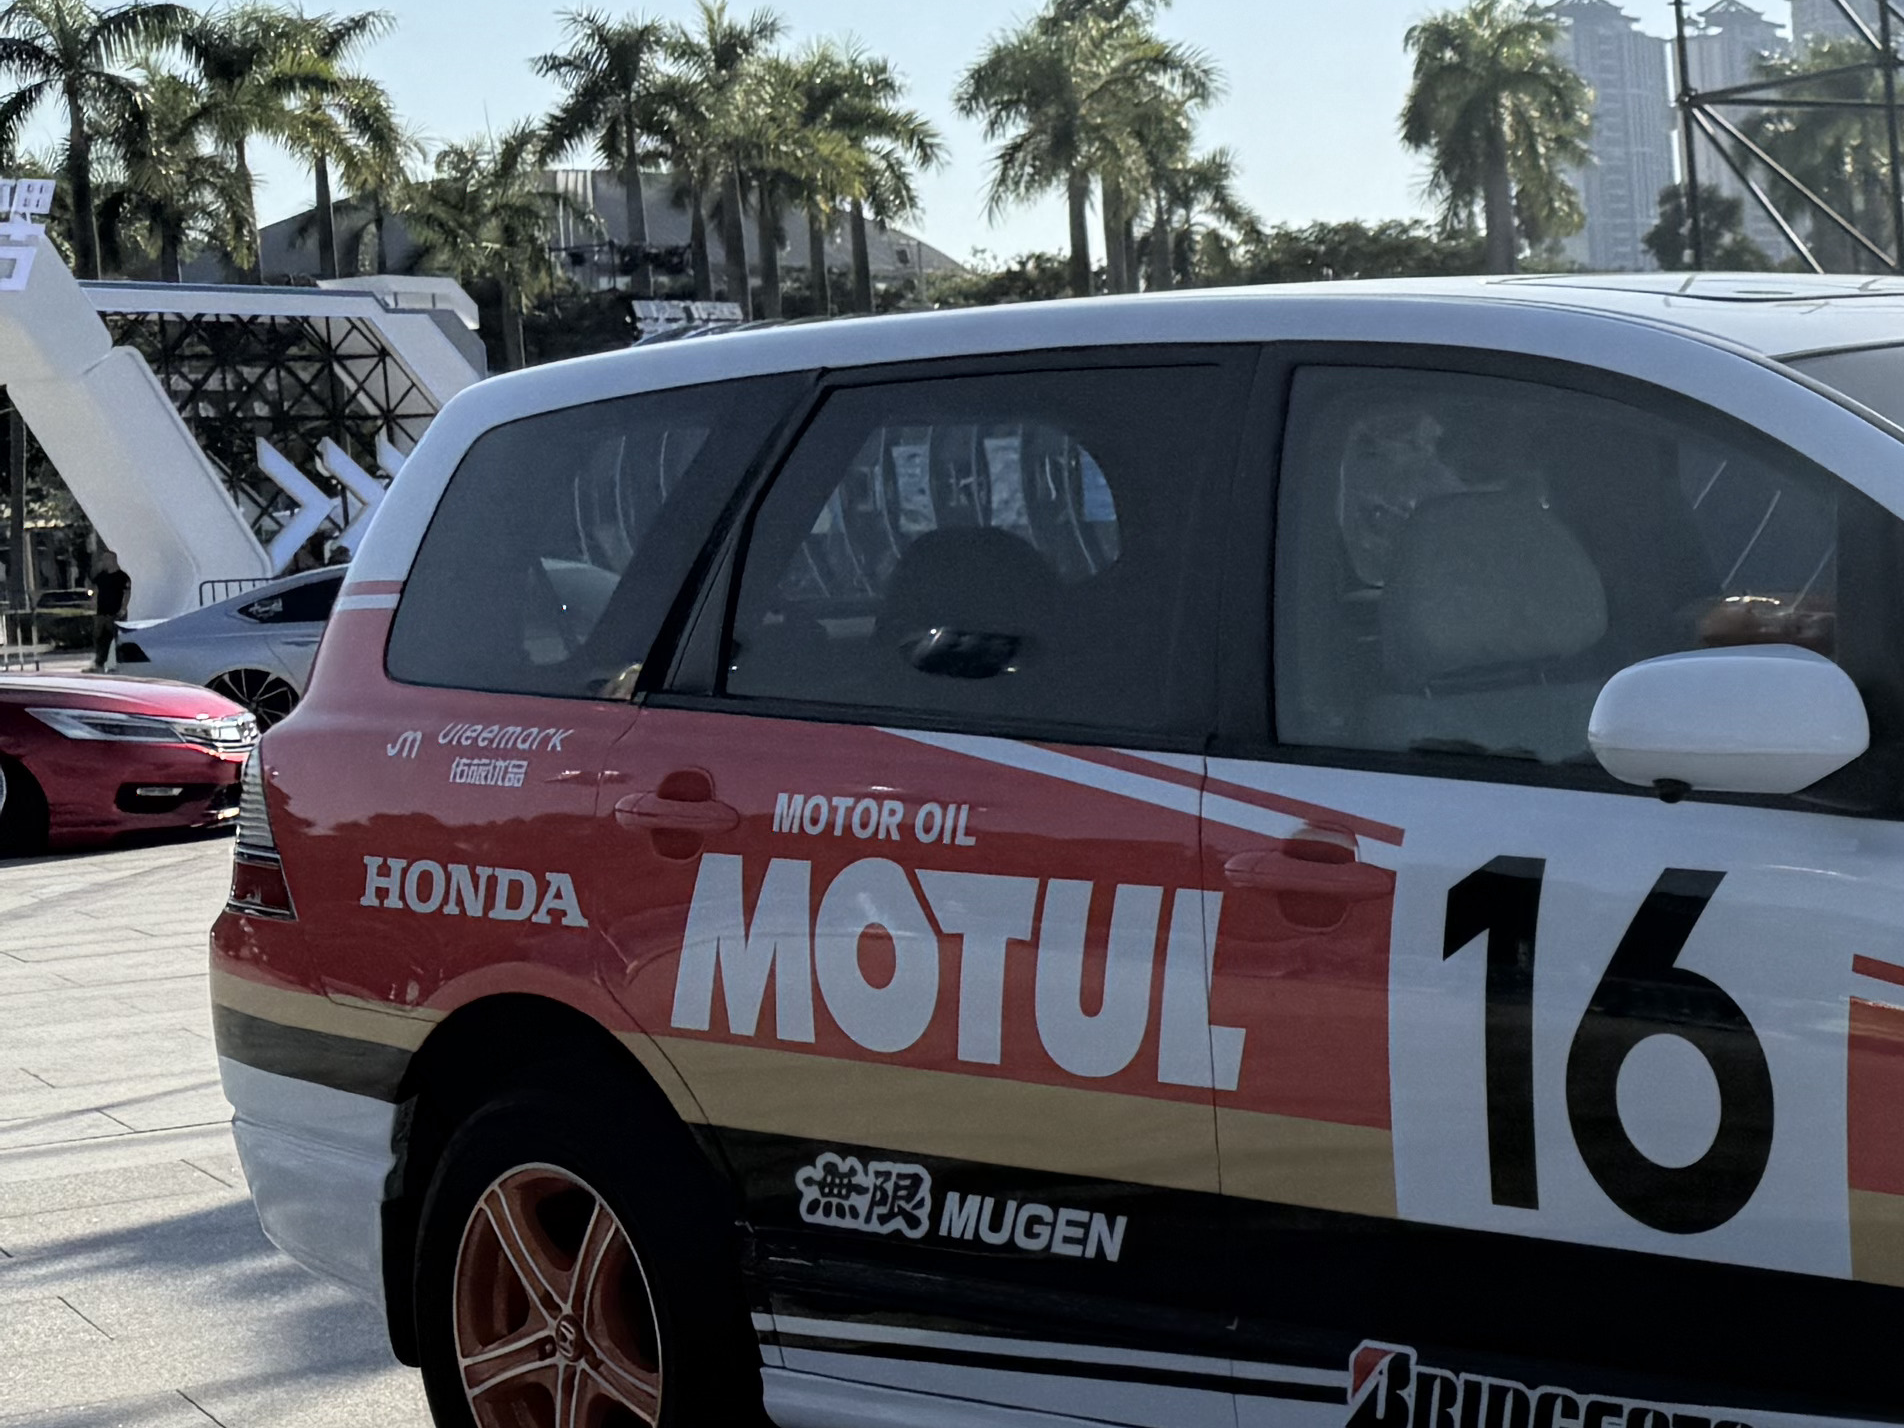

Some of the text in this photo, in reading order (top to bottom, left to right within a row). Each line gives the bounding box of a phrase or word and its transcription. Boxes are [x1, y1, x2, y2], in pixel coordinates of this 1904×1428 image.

[773, 791, 978, 847] MOTOR OIL
[359, 855, 589, 928] HONDA
[670, 852, 1248, 1092] MOTUL
[1441, 854, 1775, 1236] 16
[796, 1153, 1128, 1263] 無限 MUGEN
